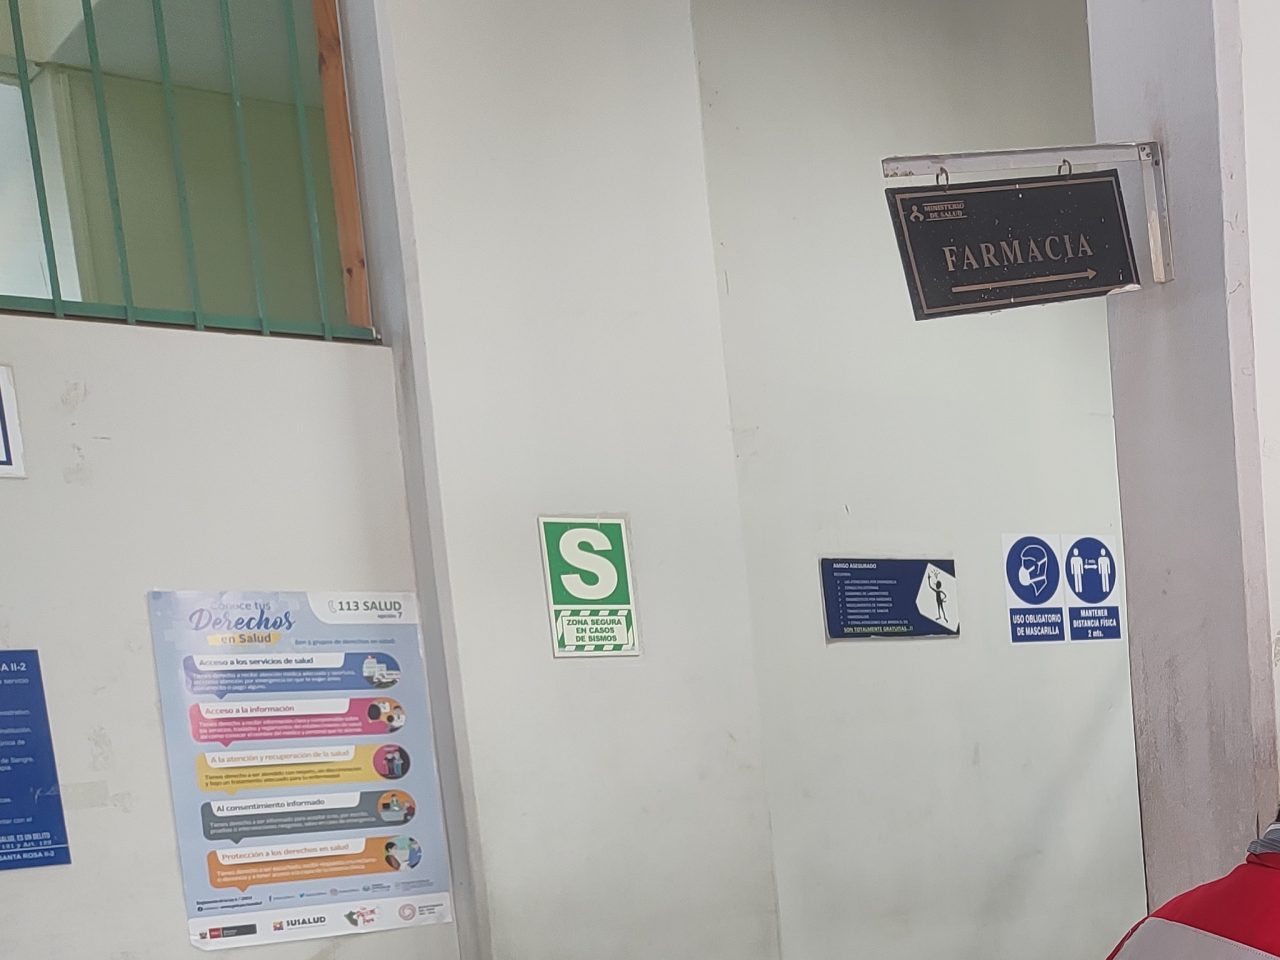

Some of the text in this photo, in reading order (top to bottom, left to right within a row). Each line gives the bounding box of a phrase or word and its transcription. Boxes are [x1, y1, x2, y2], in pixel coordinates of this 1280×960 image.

[924, 202, 965, 212] MINISTERIO
[941, 209, 963, 218] SALUD
[942, 233, 1094, 272] FARMACIA
[559, 527, 618, 600] S
[338, 601, 402, 611] 113 SALUD
[397, 611, 403, 619] 7
[1080, 609, 1108, 617] MANTENER
[189, 607, 296, 631] Derechos
[566, 618, 622, 626] ZONA SEGURA
[1012, 614, 1061, 624] USO OBLIGATORIO
[1073, 617, 1117, 628] DISTANCIA FÍSICA
[1017, 626, 1060, 636] DE MASCARILLA
[220, 632, 272, 644] en Salud
[205, 707, 234, 715] Acceso
[249, 704, 295, 712] información
[226, 754, 258, 763] atención
[265, 752, 311, 762] recuperación
[330, 750, 350, 758] salud
[226, 802, 285, 812] consentimiento
[286, 798, 325, 808] informado
[222, 851, 263, 861] Protección
[283, 847, 318, 856] derechos
[330, 843, 349, 851] salud
